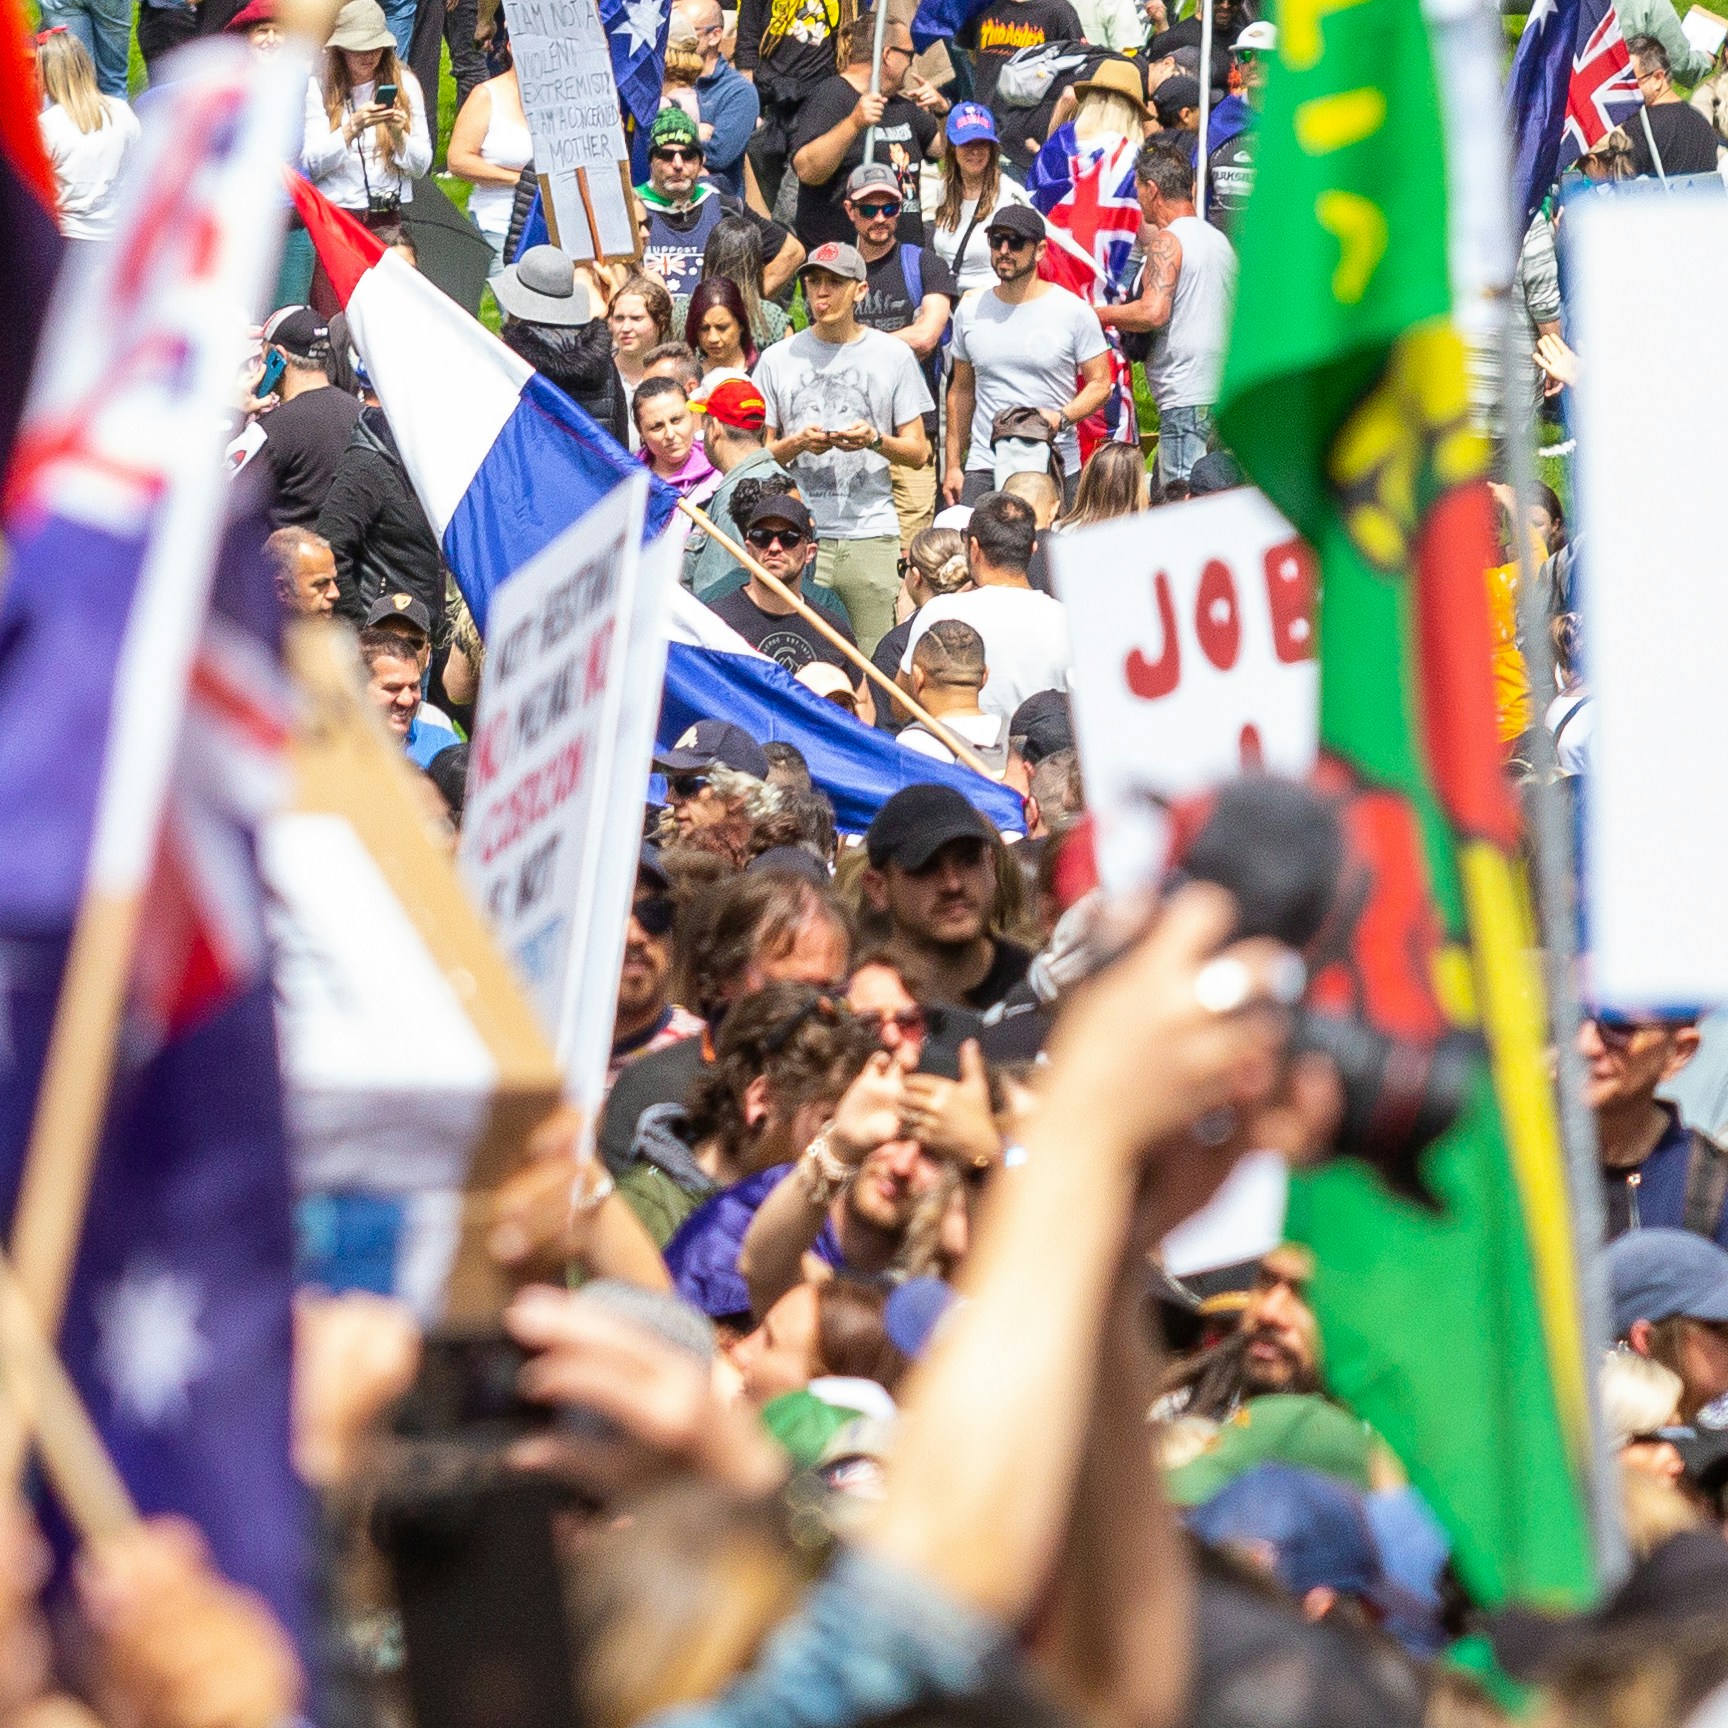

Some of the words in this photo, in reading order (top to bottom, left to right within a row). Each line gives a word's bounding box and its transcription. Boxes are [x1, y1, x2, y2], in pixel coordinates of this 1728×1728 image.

[522, 3, 549, 37] AM
[549, 0, 583, 32] NOT
[584, 0, 596, 30] A
[516, 36, 580, 80] VIOLENT
[539, 110, 559, 135] AM
[567, 104, 619, 131] CONCERNED
[548, 133, 614, 172] MOTHER
